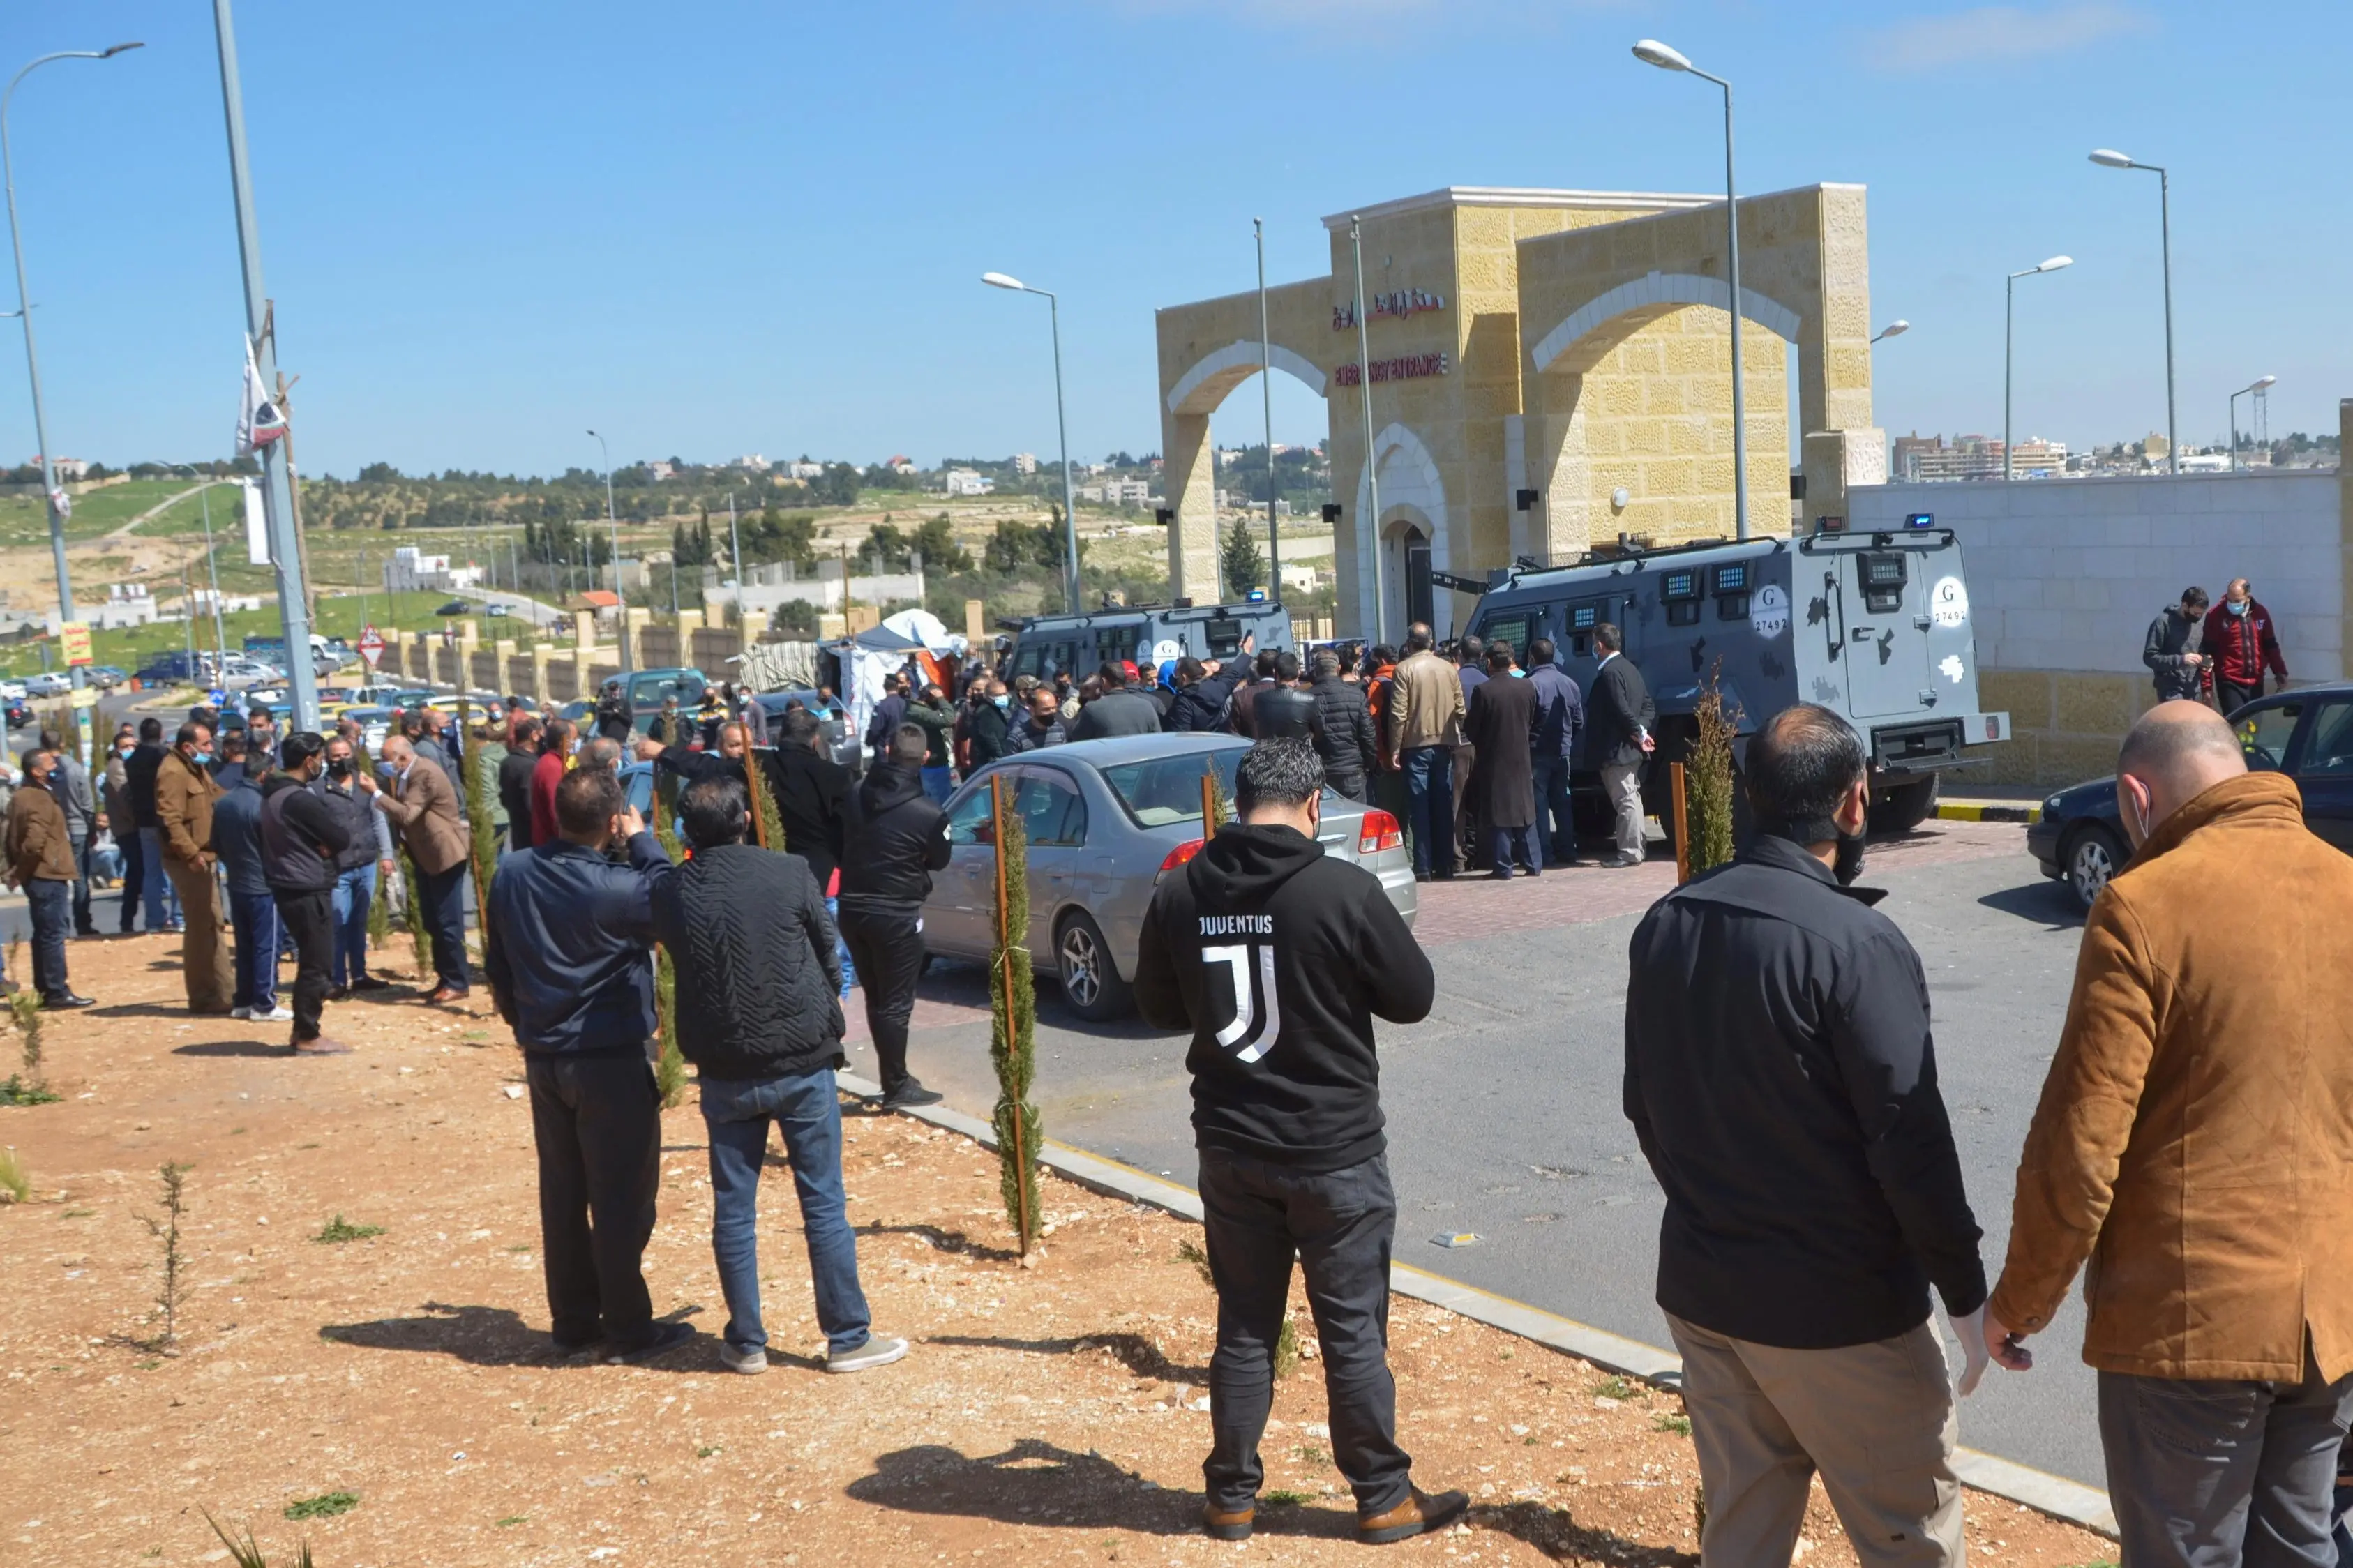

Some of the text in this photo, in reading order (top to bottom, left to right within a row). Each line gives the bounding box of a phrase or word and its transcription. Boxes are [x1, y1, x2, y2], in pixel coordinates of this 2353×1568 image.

[1335, 360, 1390, 386] EMERNCY
[1762, 589, 1775, 605] G
[1942, 585, 1954, 601] G
[1935, 610, 1966, 622] 27492
[1755, 618, 1787, 631] 27492
[1198, 914, 1272, 935] JUVENTUS
